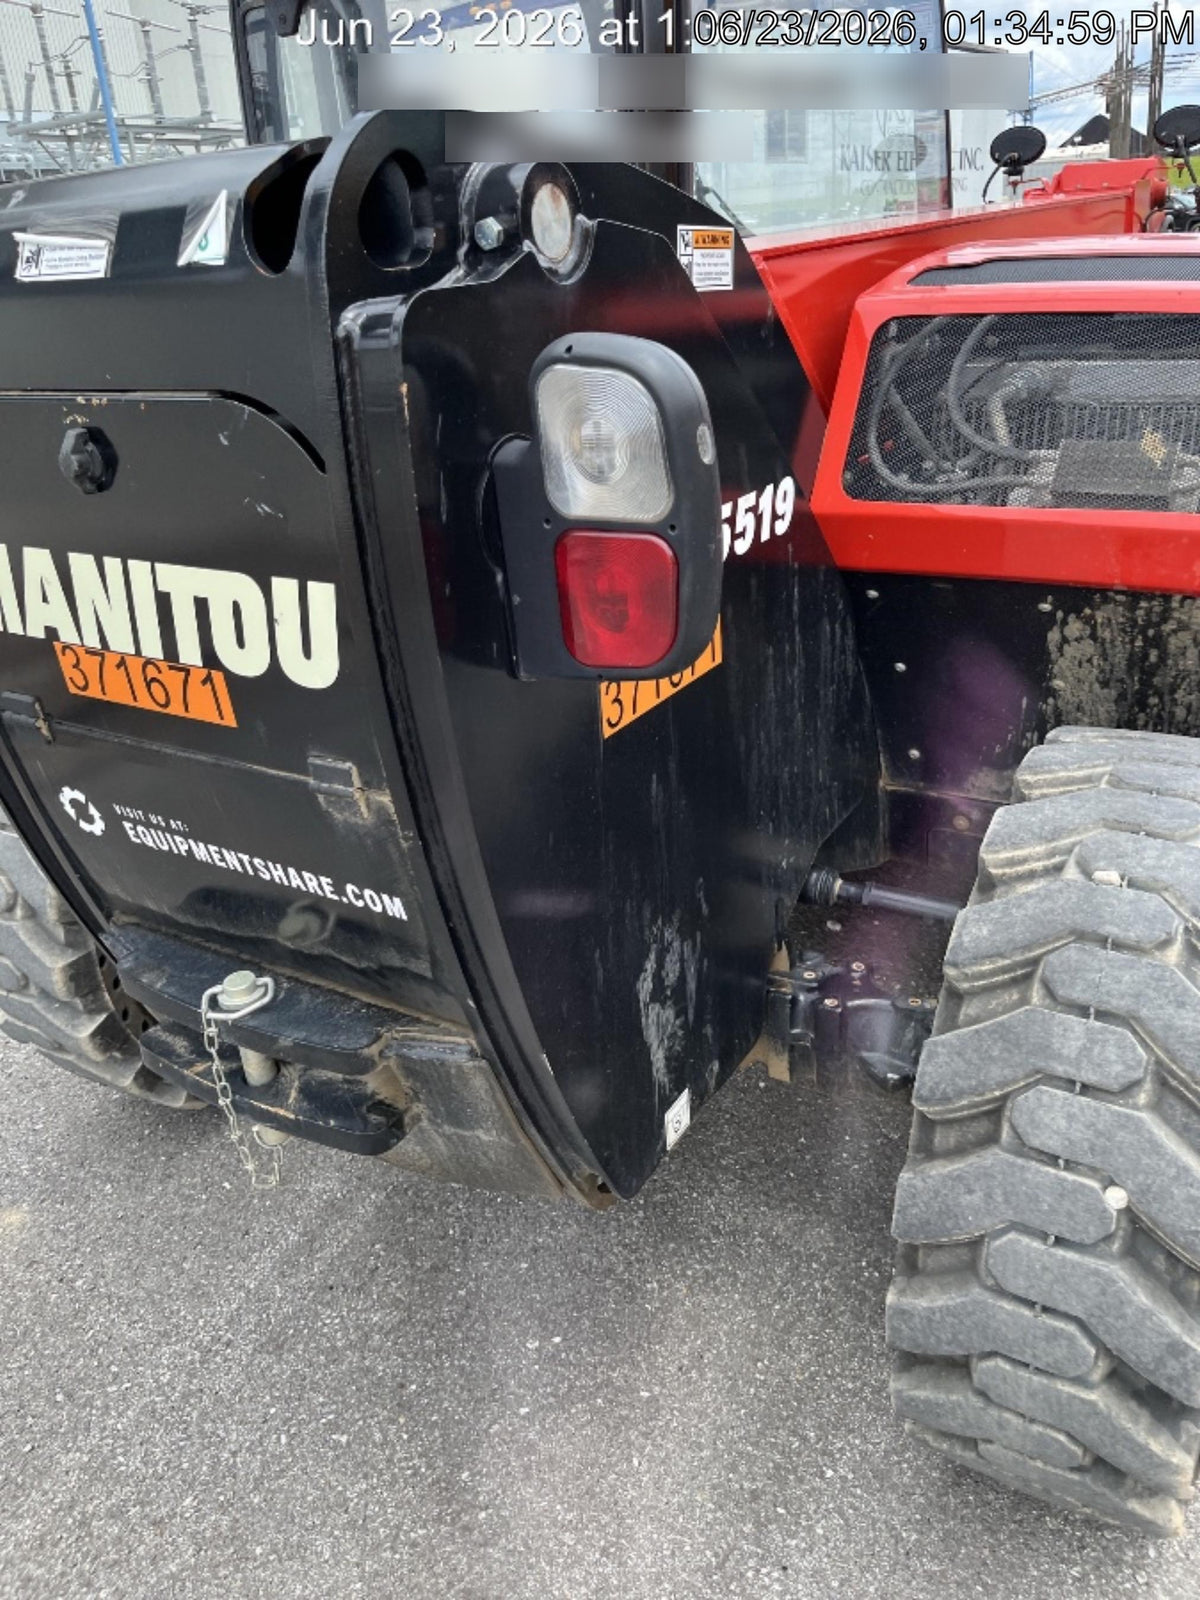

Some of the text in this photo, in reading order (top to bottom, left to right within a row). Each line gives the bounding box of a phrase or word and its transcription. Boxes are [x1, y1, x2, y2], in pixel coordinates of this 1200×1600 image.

[60, 644, 225, 722] 371671
[112, 803, 189, 832] VISIT US AT:
[122, 820, 408, 921] EQUIPMENTSHARE.COM
